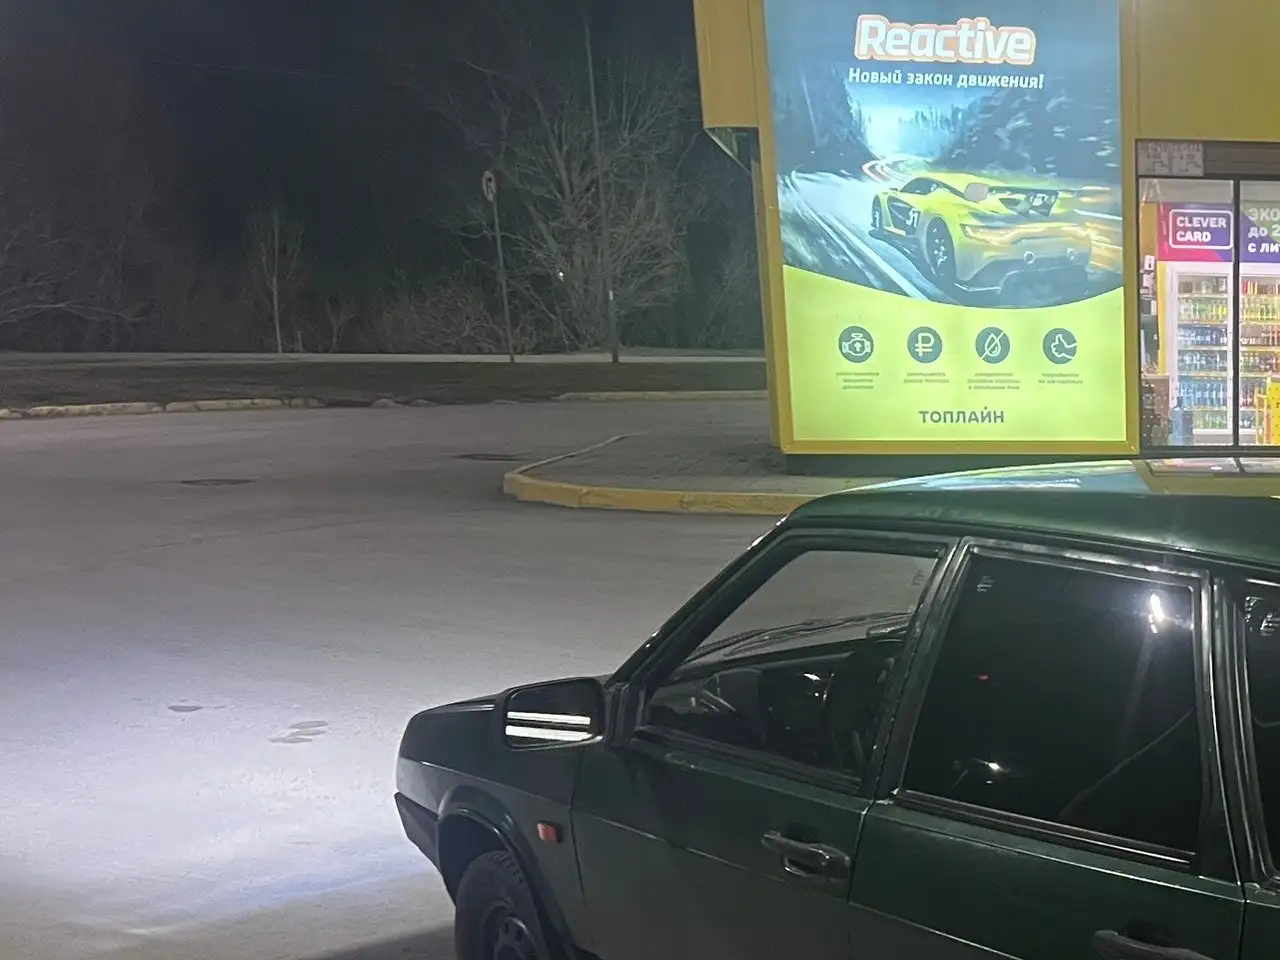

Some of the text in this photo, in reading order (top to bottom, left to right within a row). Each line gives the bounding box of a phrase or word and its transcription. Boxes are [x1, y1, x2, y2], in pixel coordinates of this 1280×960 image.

[856, 17, 1034, 62] Reactive
[848, 68, 1044, 90] Новый закон движения!
[1176, 217, 1227, 228] CLEVER
[1176, 231, 1212, 242] CARD
[1248, 227, 1268, 239] до
[1248, 243, 1257, 253] с
[918, 406, 1004, 424] ТОПЛАЙН
